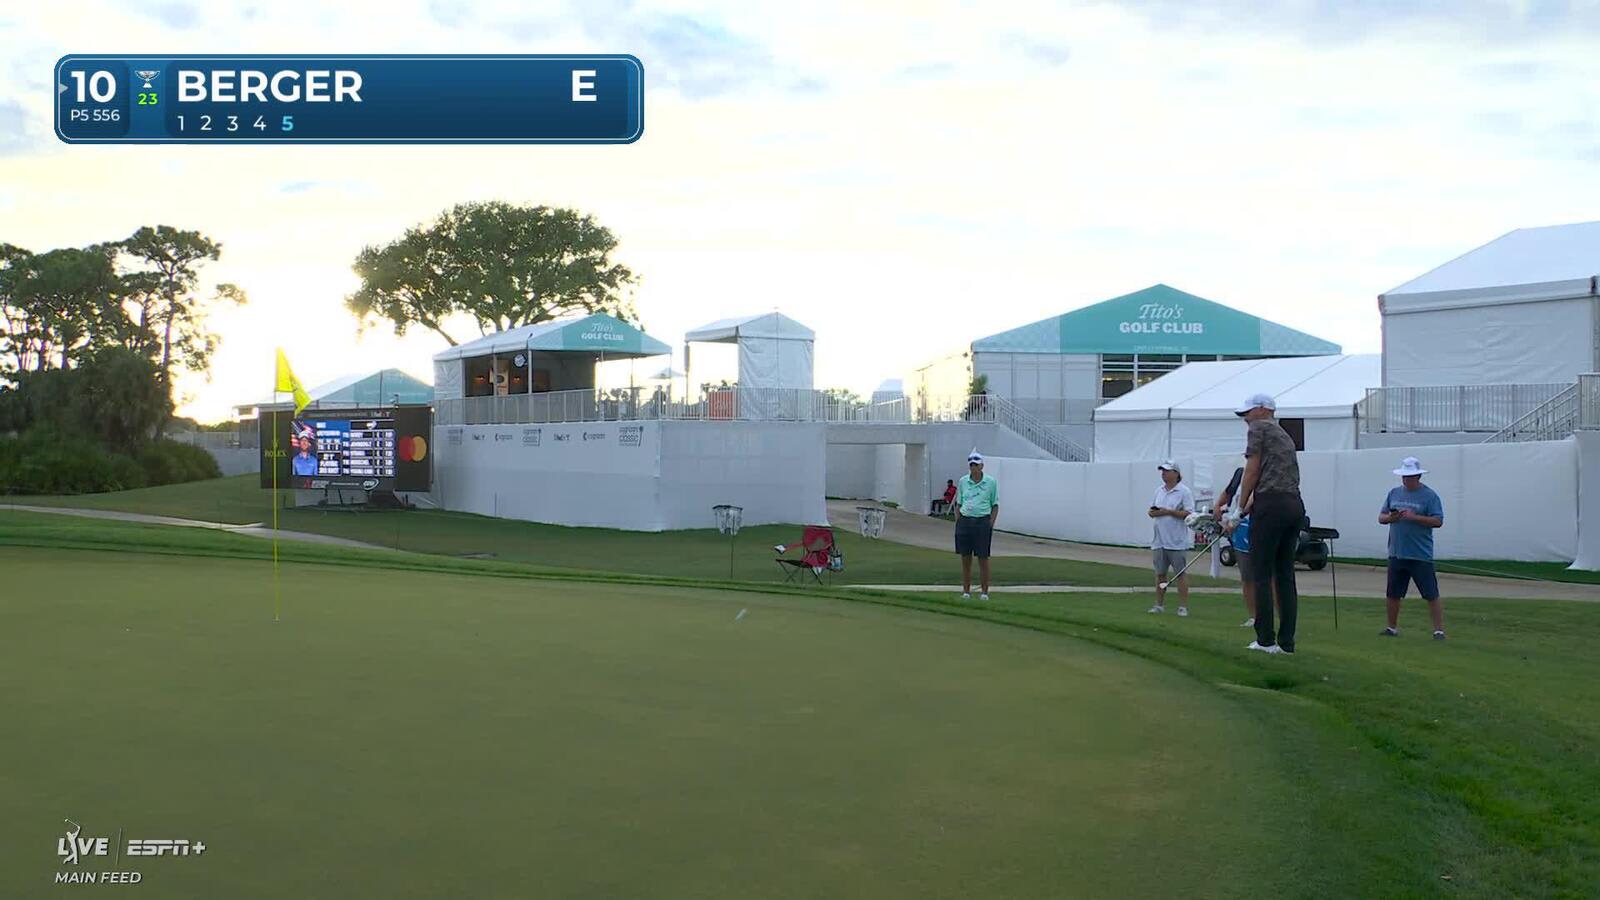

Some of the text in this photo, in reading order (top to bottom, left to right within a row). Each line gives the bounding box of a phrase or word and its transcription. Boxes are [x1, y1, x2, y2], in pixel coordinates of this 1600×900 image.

[1139, 303, 1184, 319] Tito's
[1120, 322, 1203, 334] GOLF CLUB
[581, 332, 601, 340] GOLF
